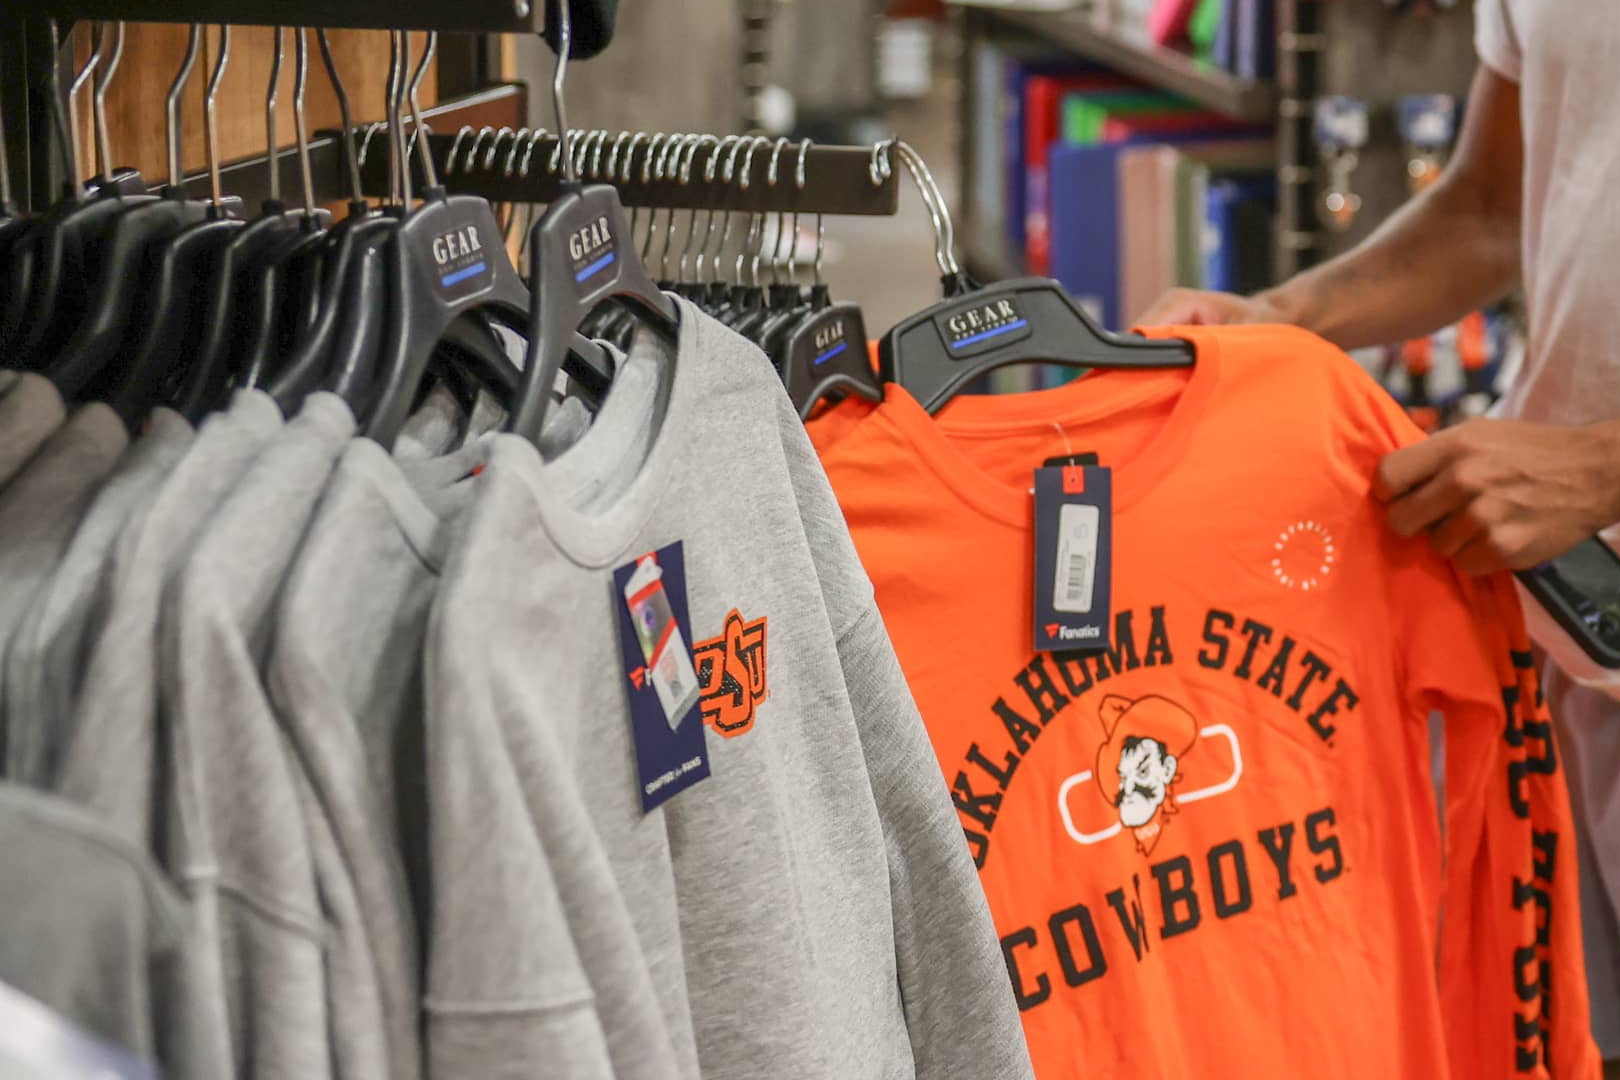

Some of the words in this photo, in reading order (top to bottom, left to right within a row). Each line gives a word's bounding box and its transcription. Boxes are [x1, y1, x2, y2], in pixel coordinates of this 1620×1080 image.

[433, 225, 482, 265] GEAR
[569, 217, 612, 261] GEAR
[949, 298, 1016, 333] GEAR
[1058, 624, 1100, 641] Fanatics
[1198, 608, 1360, 740] STATE
[1000, 807, 1344, 1012] COWBOYS
